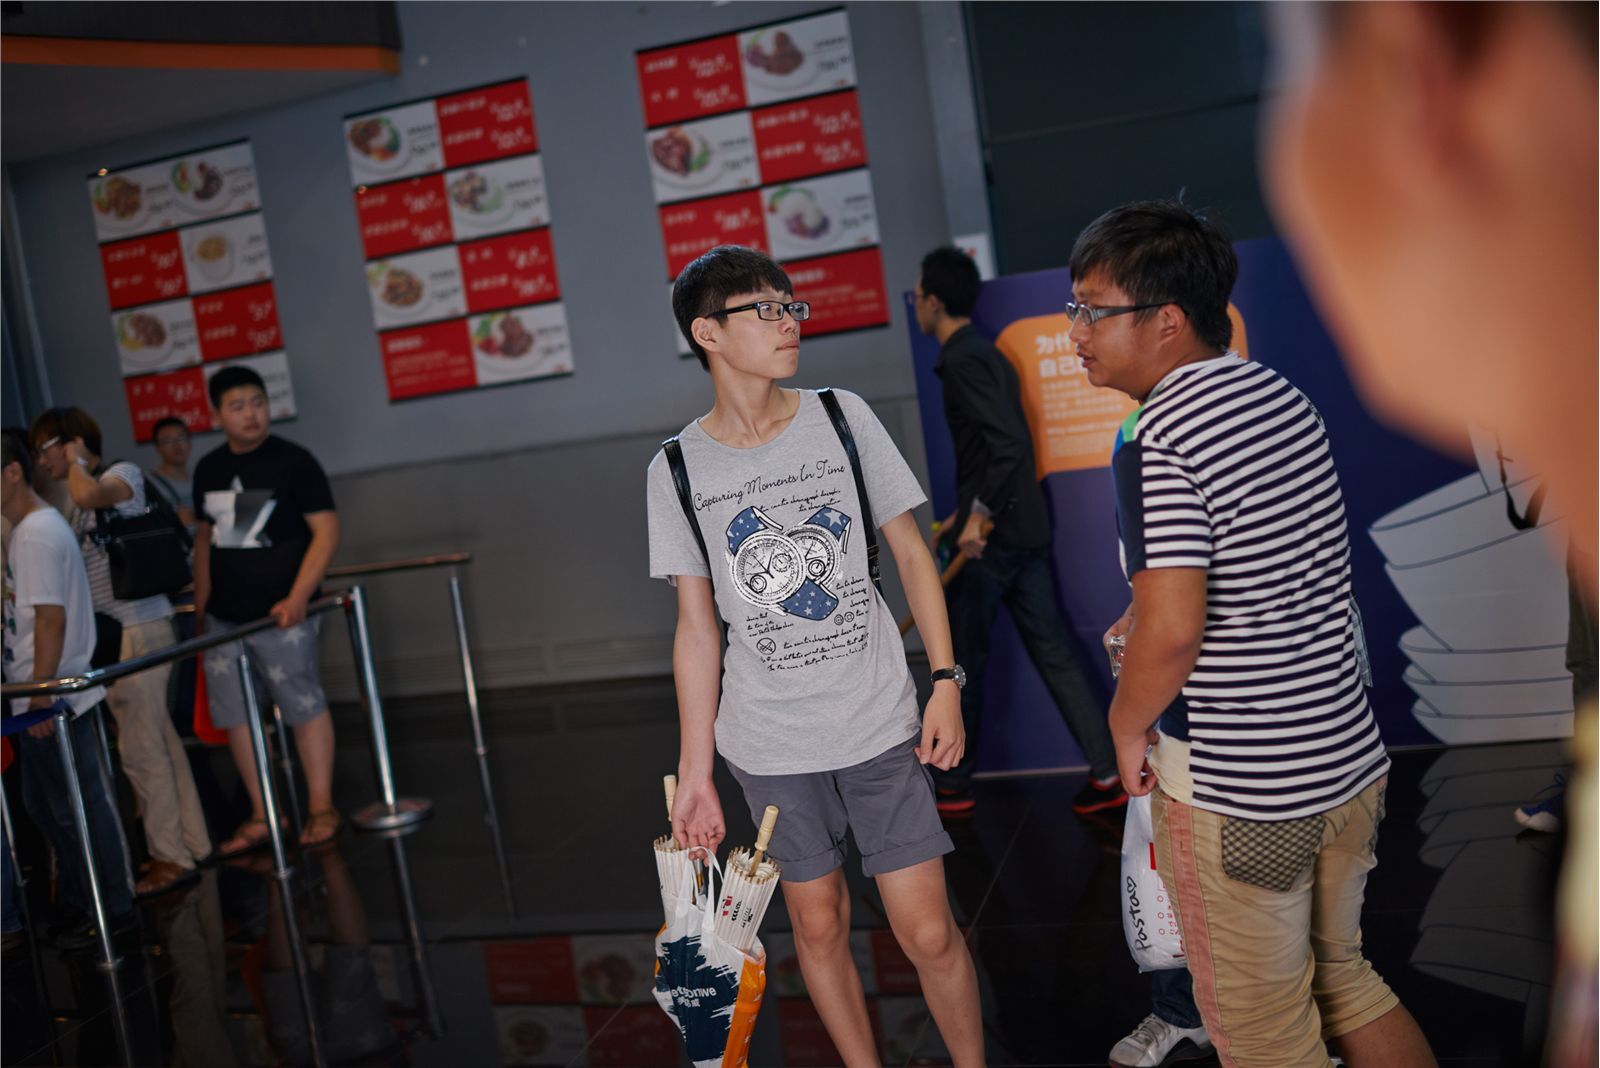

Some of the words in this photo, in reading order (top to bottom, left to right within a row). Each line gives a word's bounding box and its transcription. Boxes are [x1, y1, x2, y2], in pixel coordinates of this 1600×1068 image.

[1035, 331, 1078, 355] 为什
[694, 490, 744, 512] Capturing
[744, 476, 798, 495] Moments
[800, 464, 815, 482] In
[816, 459, 846, 479] Time
